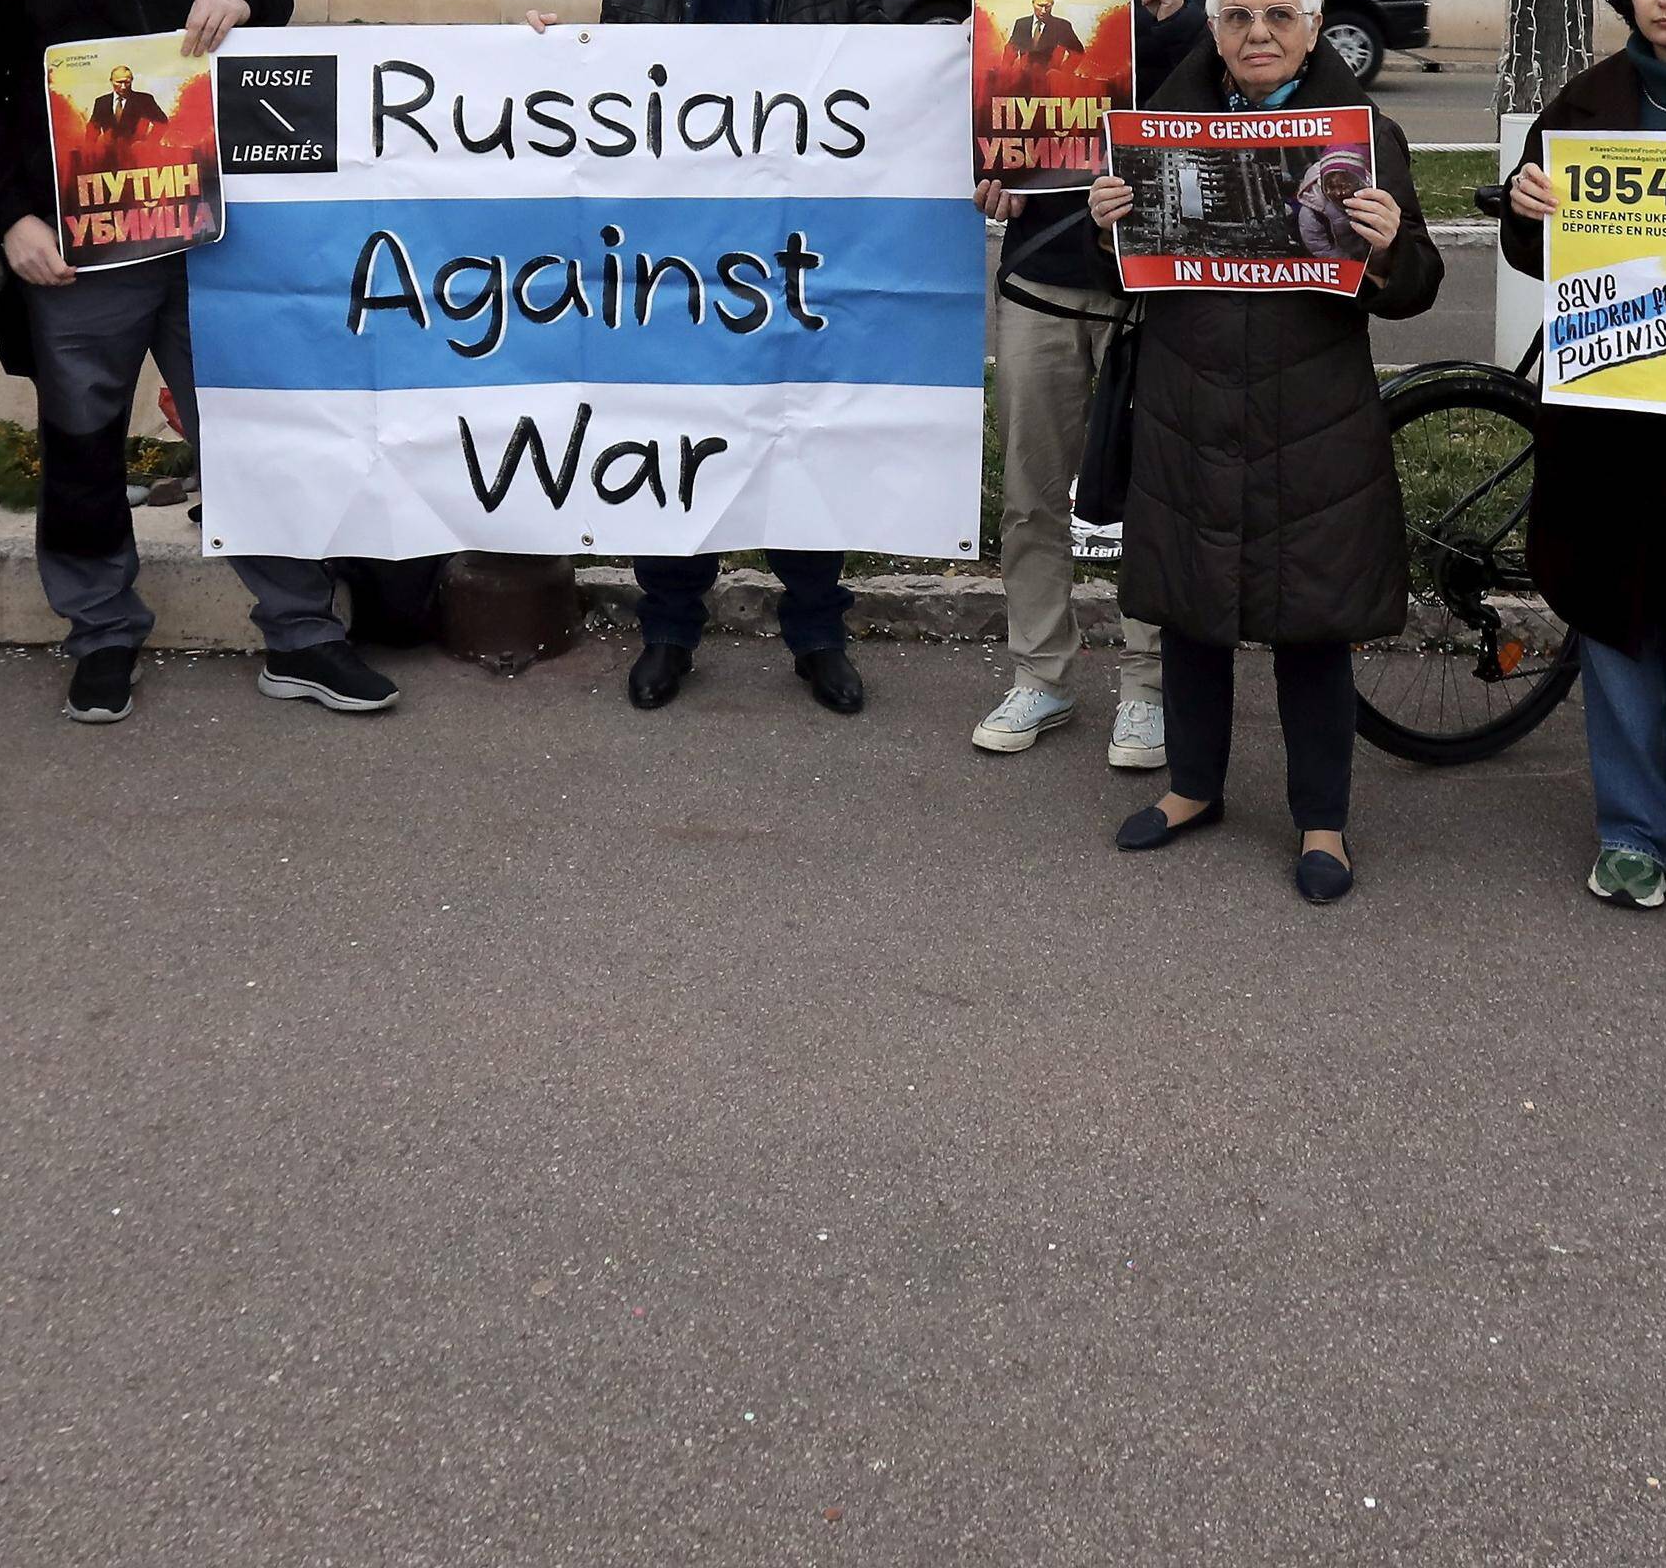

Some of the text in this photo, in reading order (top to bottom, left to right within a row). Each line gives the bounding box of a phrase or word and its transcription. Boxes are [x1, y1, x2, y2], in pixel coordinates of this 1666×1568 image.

[241, 69, 313, 87] RUSSIE
[370, 57, 872, 161] Russians
[992, 96, 1112, 130] ПУТИН
[1140, 117, 1333, 139] STOP GENOCIDE
[232, 139, 323, 162] LIBERTÉS
[977, 130, 1107, 175] УБИЙЦ
[76, 163, 200, 207] ПУТИН
[64, 199, 218, 247] УБИЙЦА
[1562, 209, 1584, 220] LES
[1586, 210, 1642, 223] ENFANTS
[1562, 221, 1623, 235] DÉPORTÉS
[1626, 225, 1643, 236] EN
[1173, 260, 1341, 285] IN UKRAINE
[344, 221, 831, 361] Against
[454, 400, 730, 516] War
